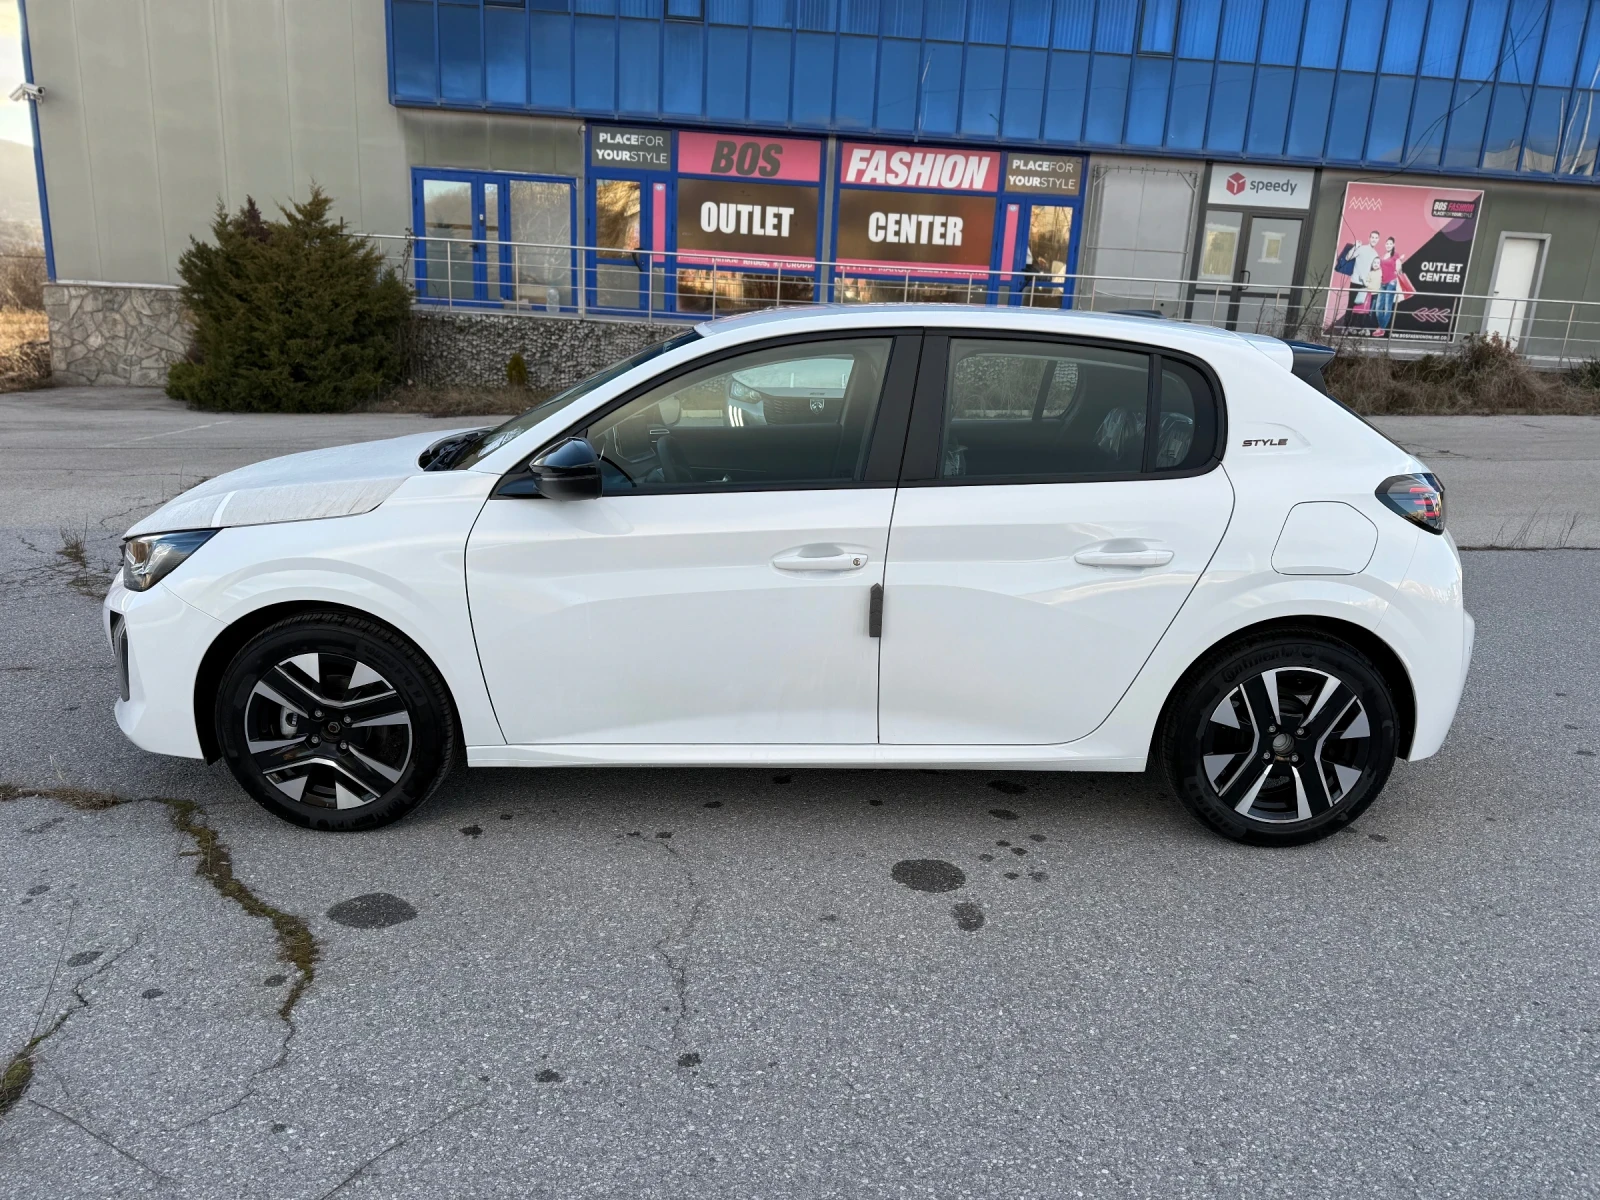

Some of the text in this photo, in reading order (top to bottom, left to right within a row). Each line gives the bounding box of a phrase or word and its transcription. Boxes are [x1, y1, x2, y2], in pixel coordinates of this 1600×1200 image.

[599, 132, 664, 147] PLACEFOR
[596, 149, 668, 164] YOURSTYLE
[710, 140, 783, 177] BOS
[845, 148, 991, 190] FASHION
[1012, 159, 1074, 173] PLACEFOR
[1008, 175, 1076, 190] YOURSTYLE
[1249, 178, 1298, 196] speedy
[1433, 201, 1475, 213] BOS FASHION
[700, 201, 795, 238] OUTLET
[867, 212, 964, 247] CENTER
[1421, 261, 1463, 273] OUTLET
[1418, 271, 1460, 284] CENTER
[1242, 438, 1288, 447] STYLE
